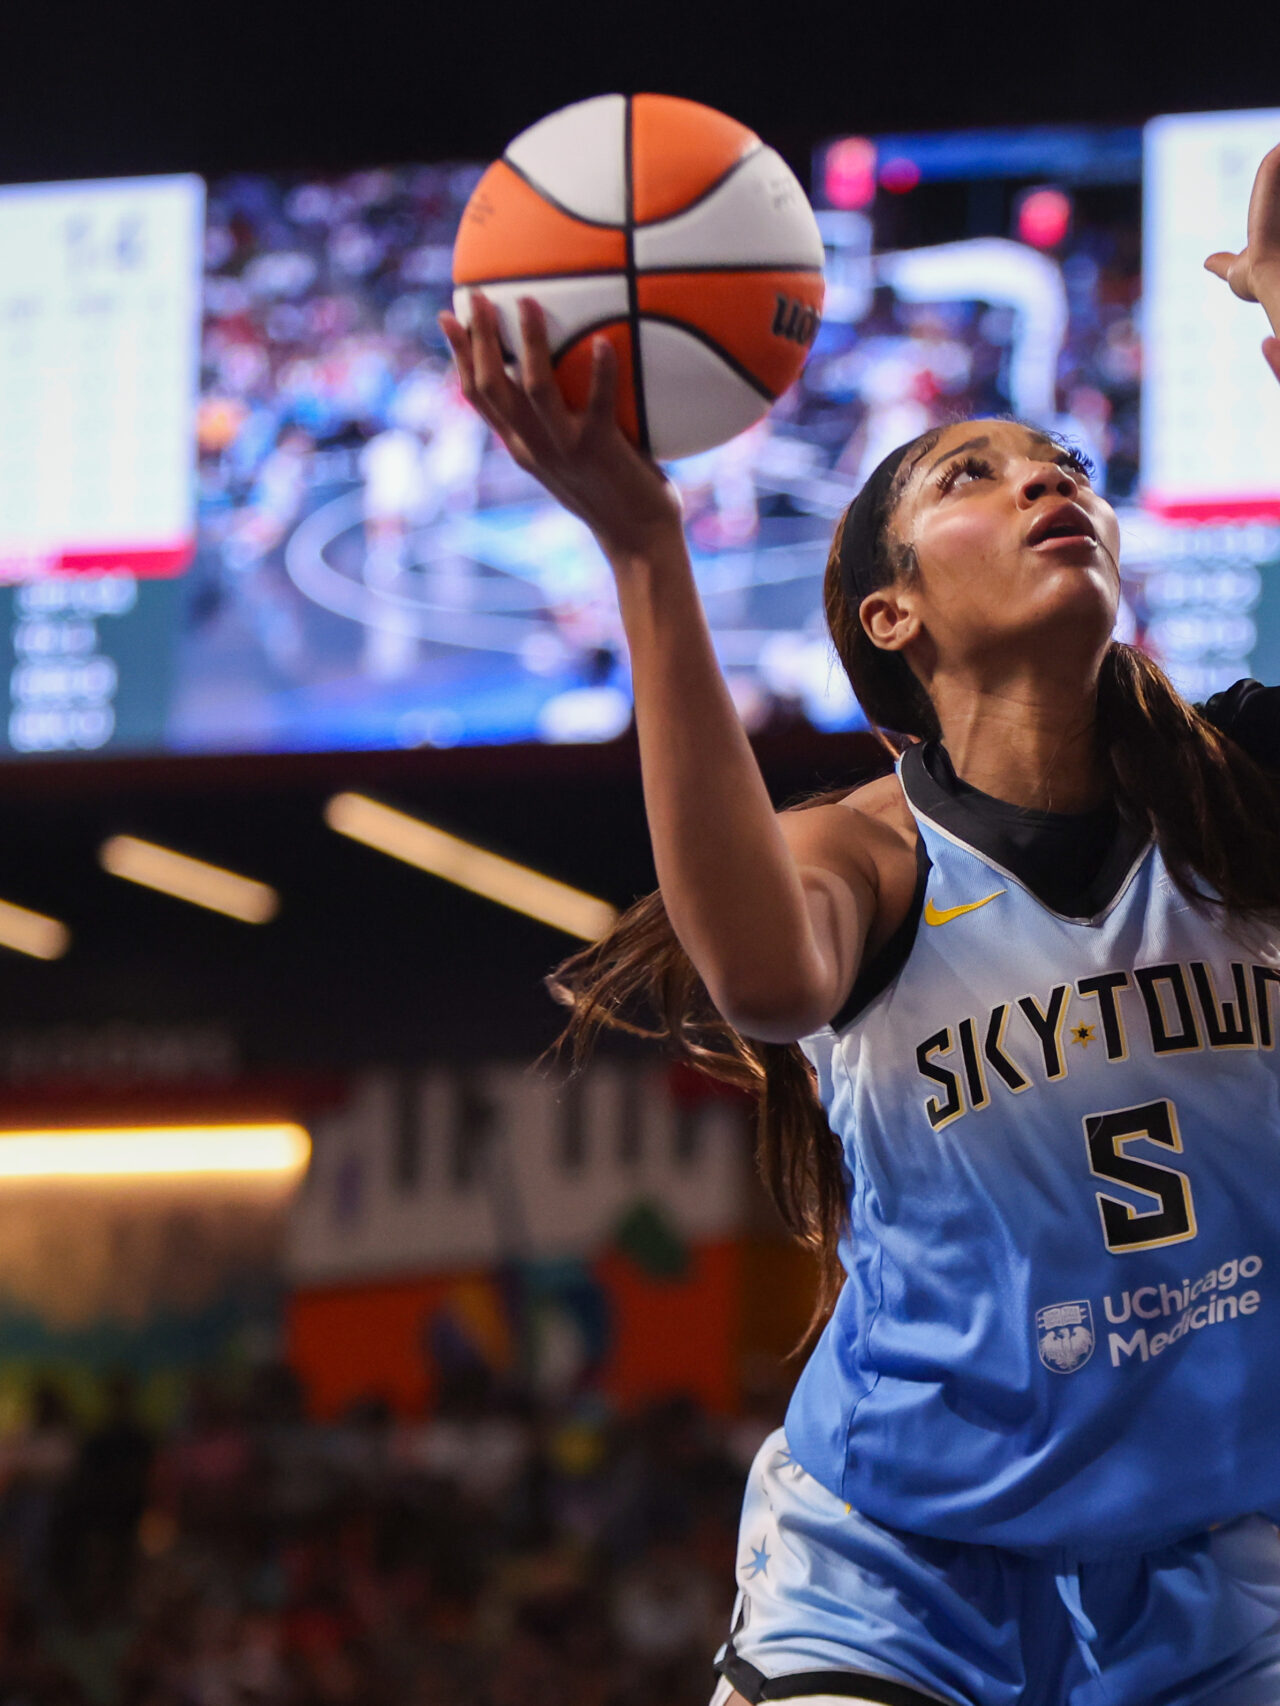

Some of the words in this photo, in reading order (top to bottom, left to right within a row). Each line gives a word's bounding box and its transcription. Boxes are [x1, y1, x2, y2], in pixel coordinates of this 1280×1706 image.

[1082, 1097, 1197, 1254] 5
[1103, 1254, 1263, 1324] UChicago
[1107, 1289, 1261, 1368] Medicine
